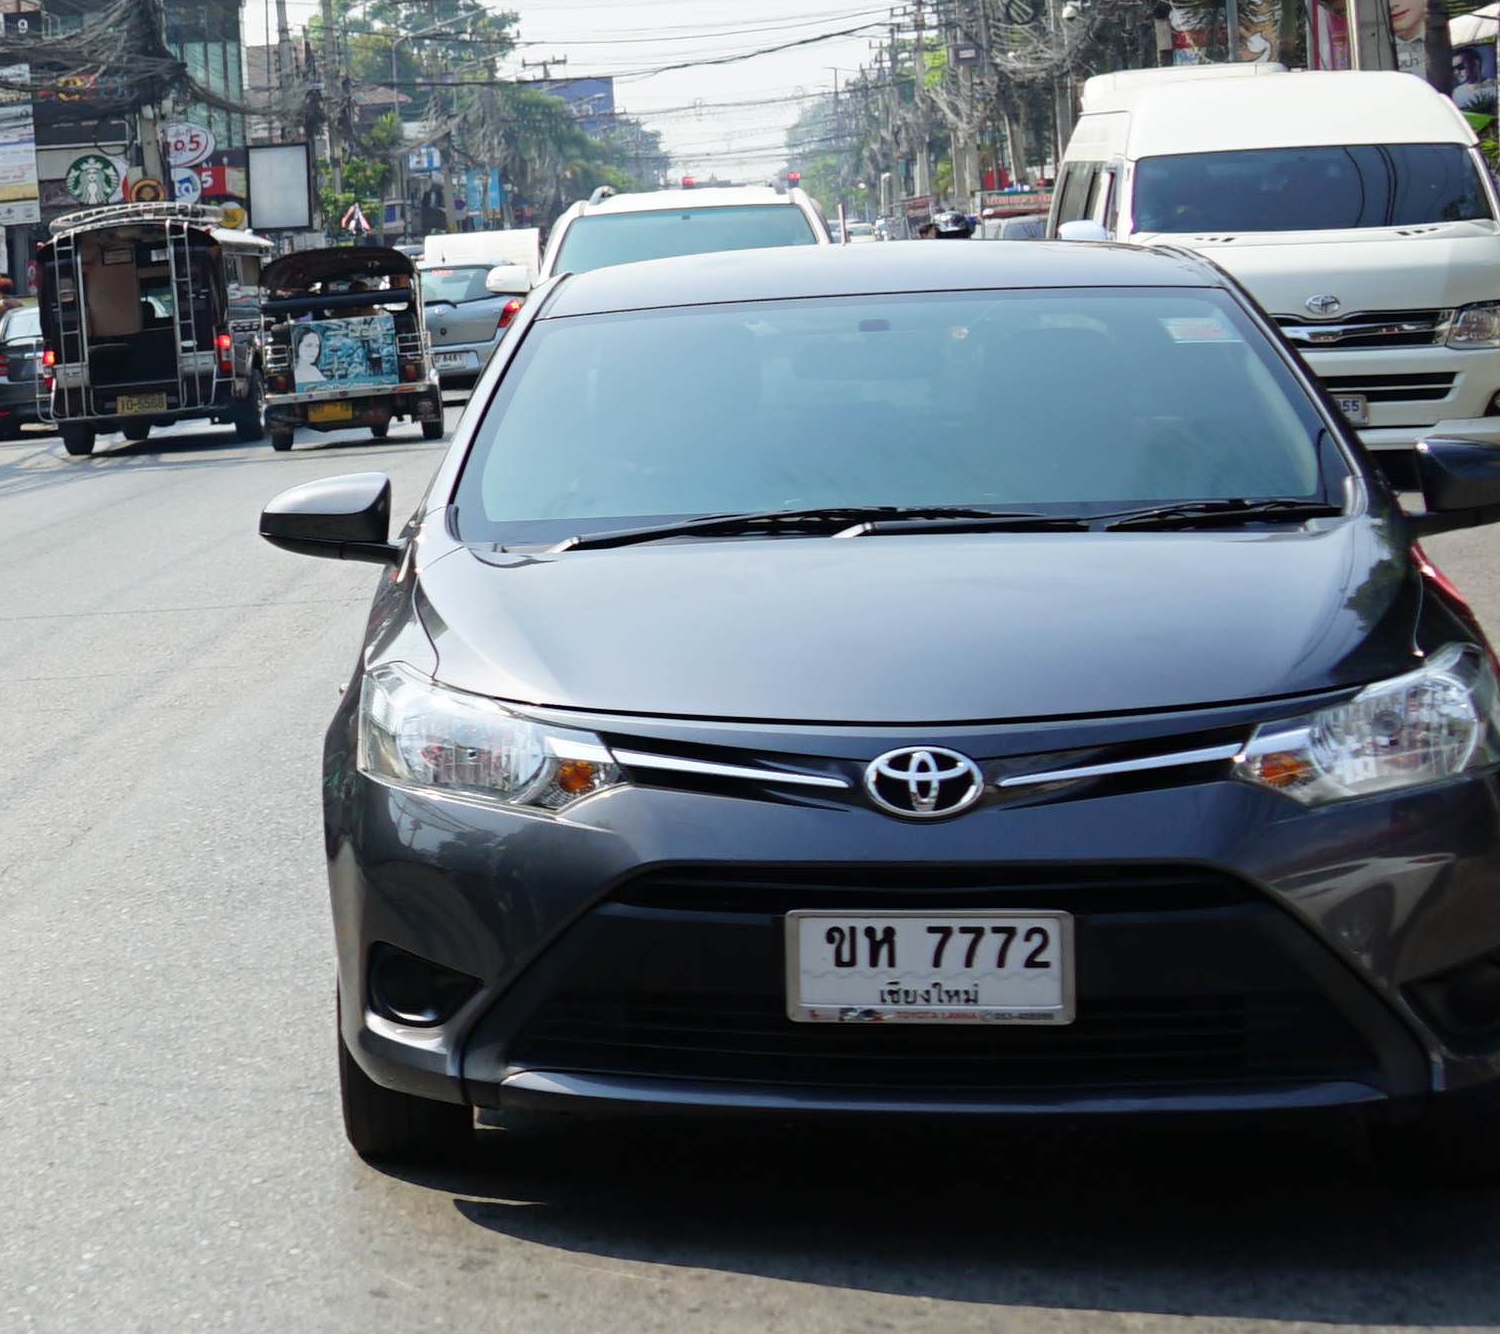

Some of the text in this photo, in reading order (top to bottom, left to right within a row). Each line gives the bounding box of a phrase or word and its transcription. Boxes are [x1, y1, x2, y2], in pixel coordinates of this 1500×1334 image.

[1336, 399, 1361, 412] 55
[926, 926, 1051, 970] 7772
[880, 981, 979, 1005] เชียงใหม่
